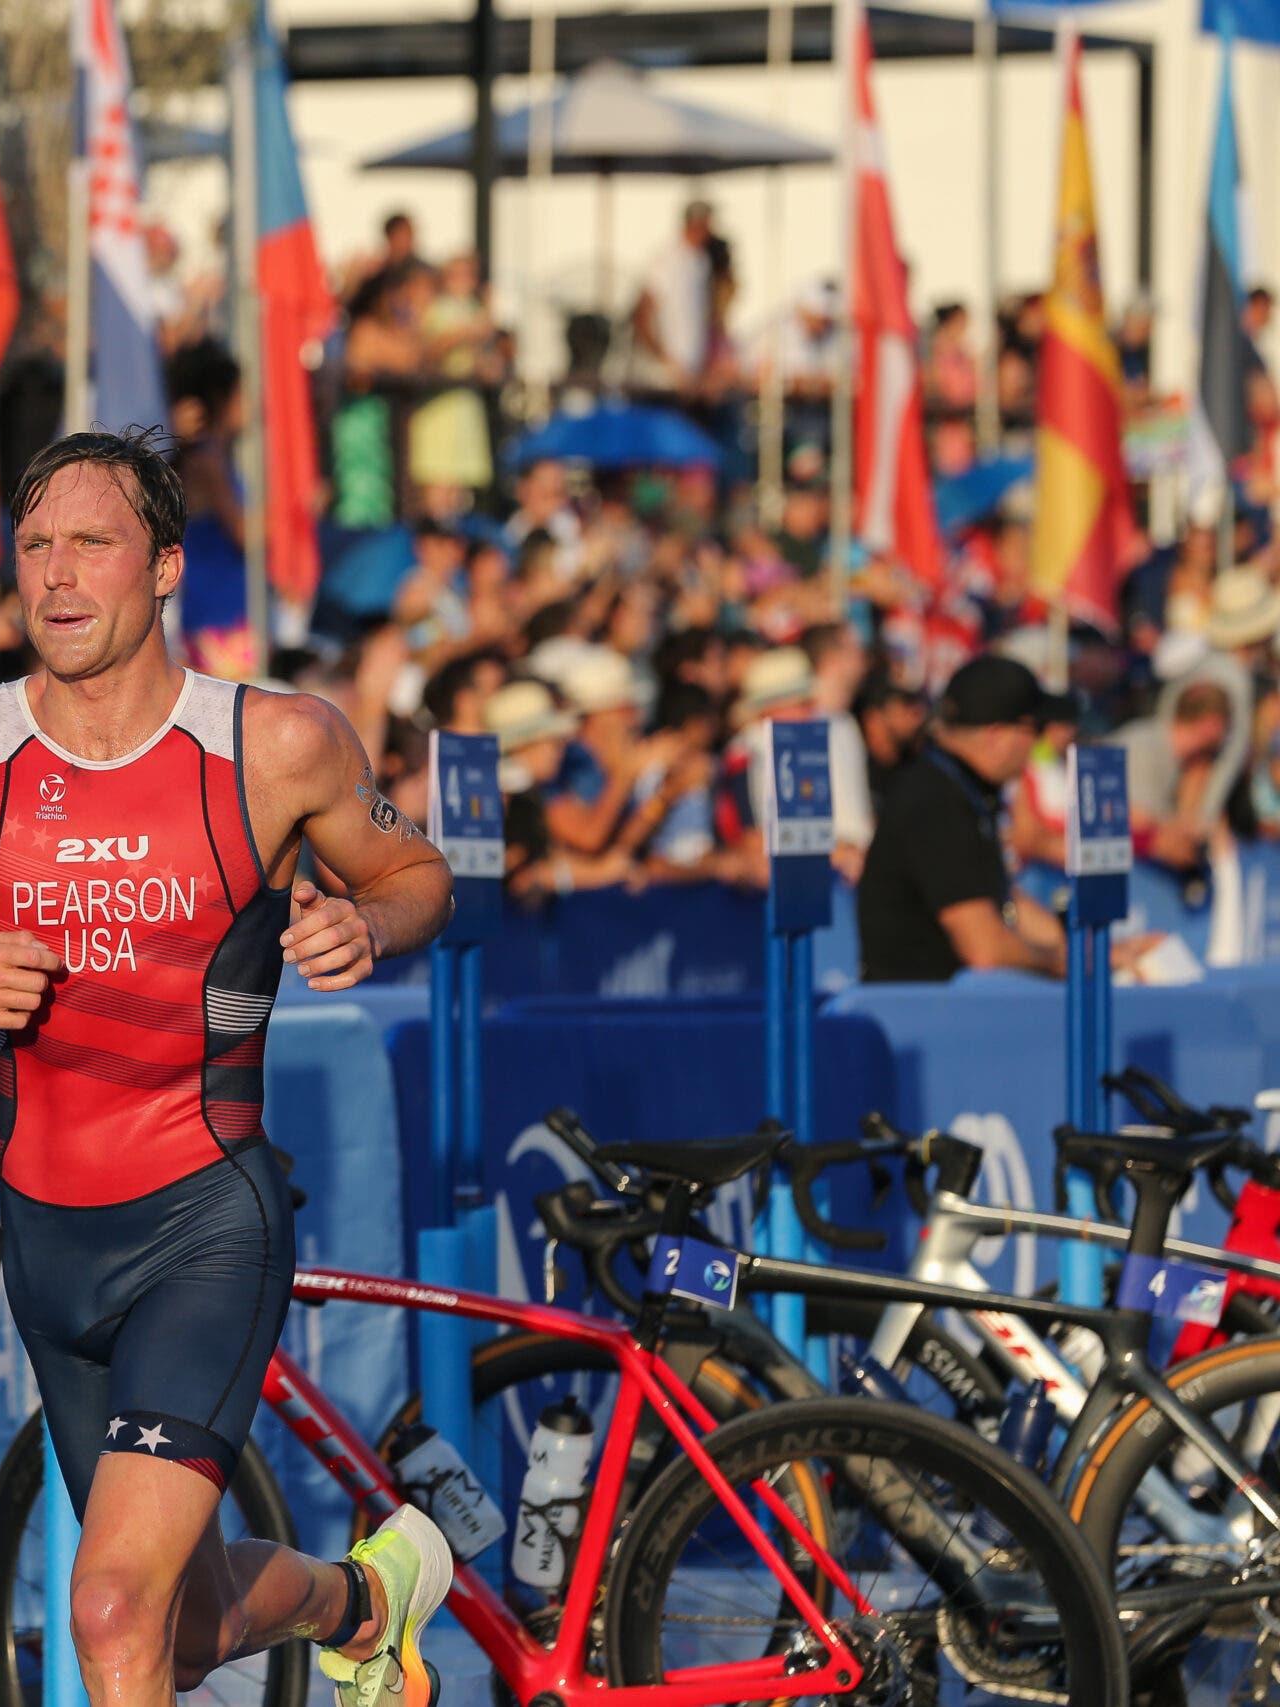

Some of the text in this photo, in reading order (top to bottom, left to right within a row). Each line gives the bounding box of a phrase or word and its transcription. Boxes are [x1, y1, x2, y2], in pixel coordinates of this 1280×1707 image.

[34, 811, 68, 820] Triathlon
[40, 804, 63, 812] World
[55, 835, 150, 863] 2XU
[12, 876, 196, 926] PEARSON
[64, 927, 137, 974] USA
[663, 1248, 680, 1276] 2
[293, 1272, 347, 1291] REK
[1148, 1269, 1166, 1298] 4
[427, 1465, 482, 1535] MURTEN
